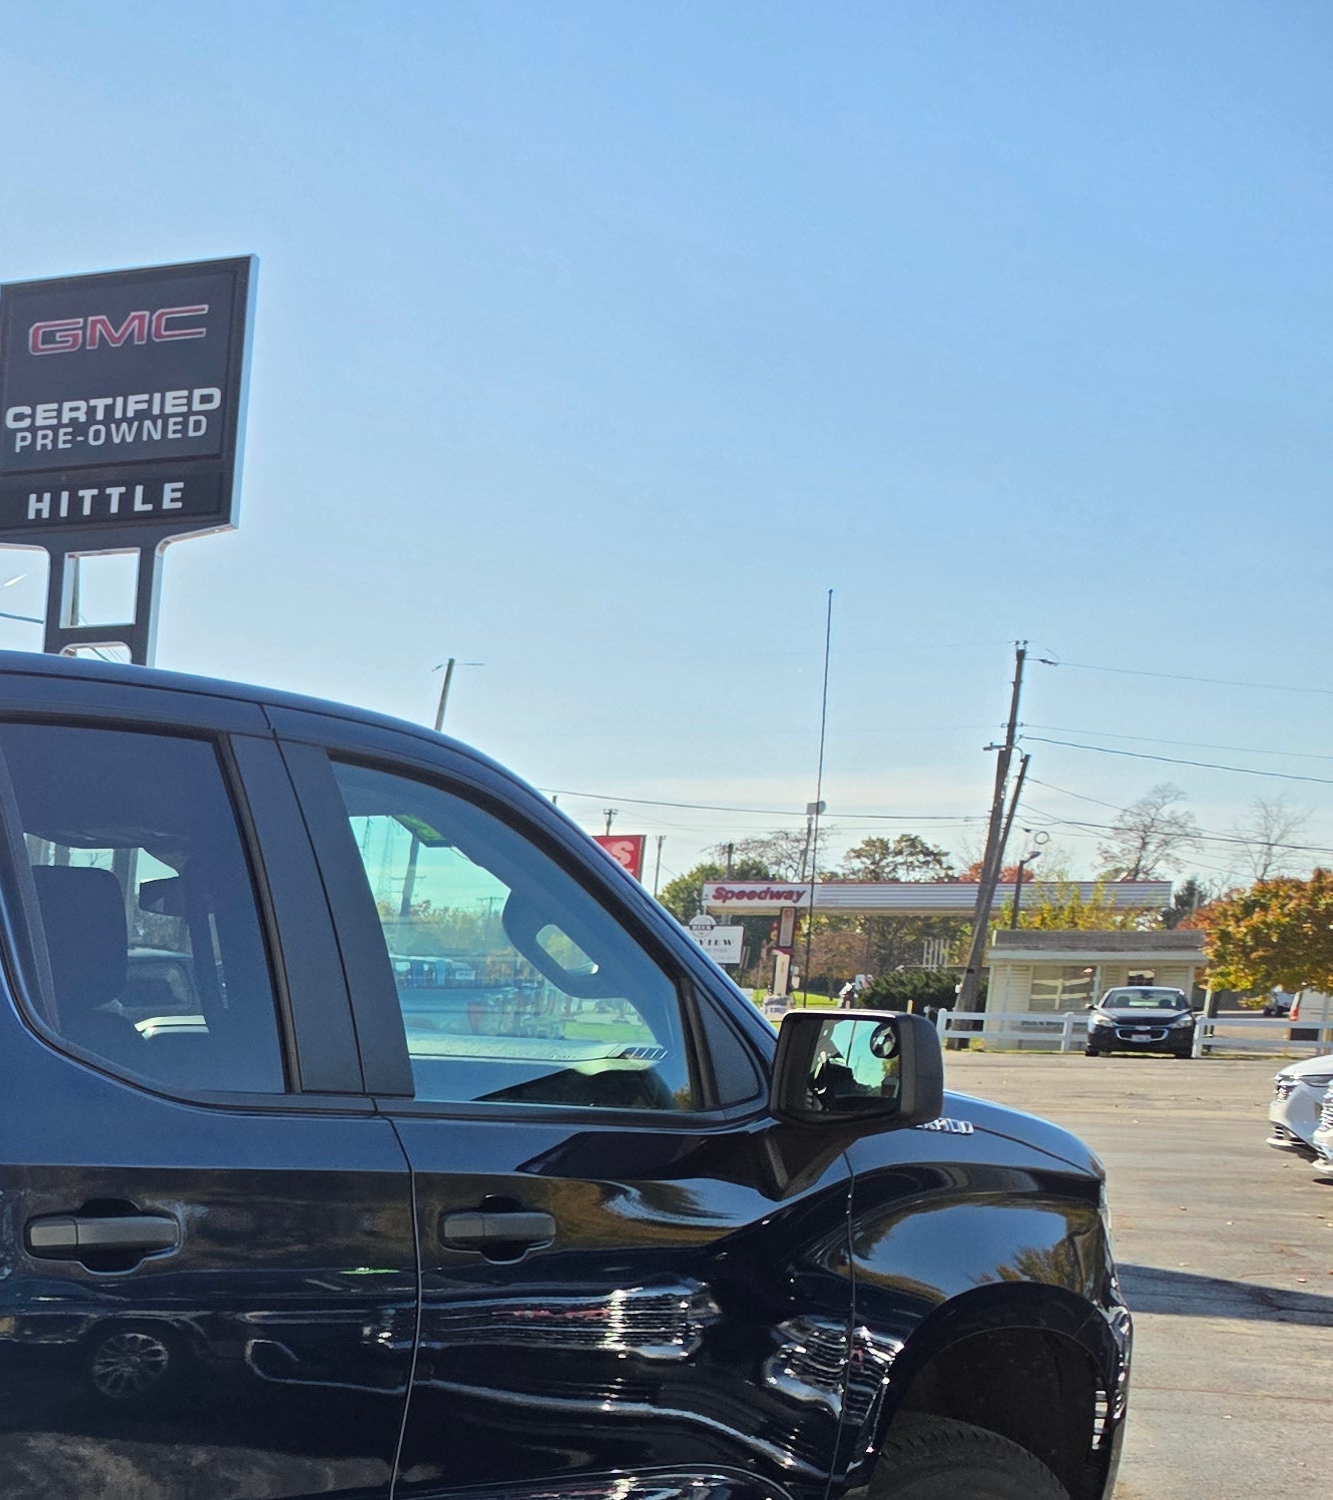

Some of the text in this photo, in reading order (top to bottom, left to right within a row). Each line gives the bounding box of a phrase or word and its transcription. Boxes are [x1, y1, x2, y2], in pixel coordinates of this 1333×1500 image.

[28, 304, 209, 356] GMC
[5, 387, 222, 429] CERTIFIED
[14, 415, 208, 453] PRE-OWNED
[27, 482, 185, 520] HITTLE
[712, 887, 806, 904] Speedway
